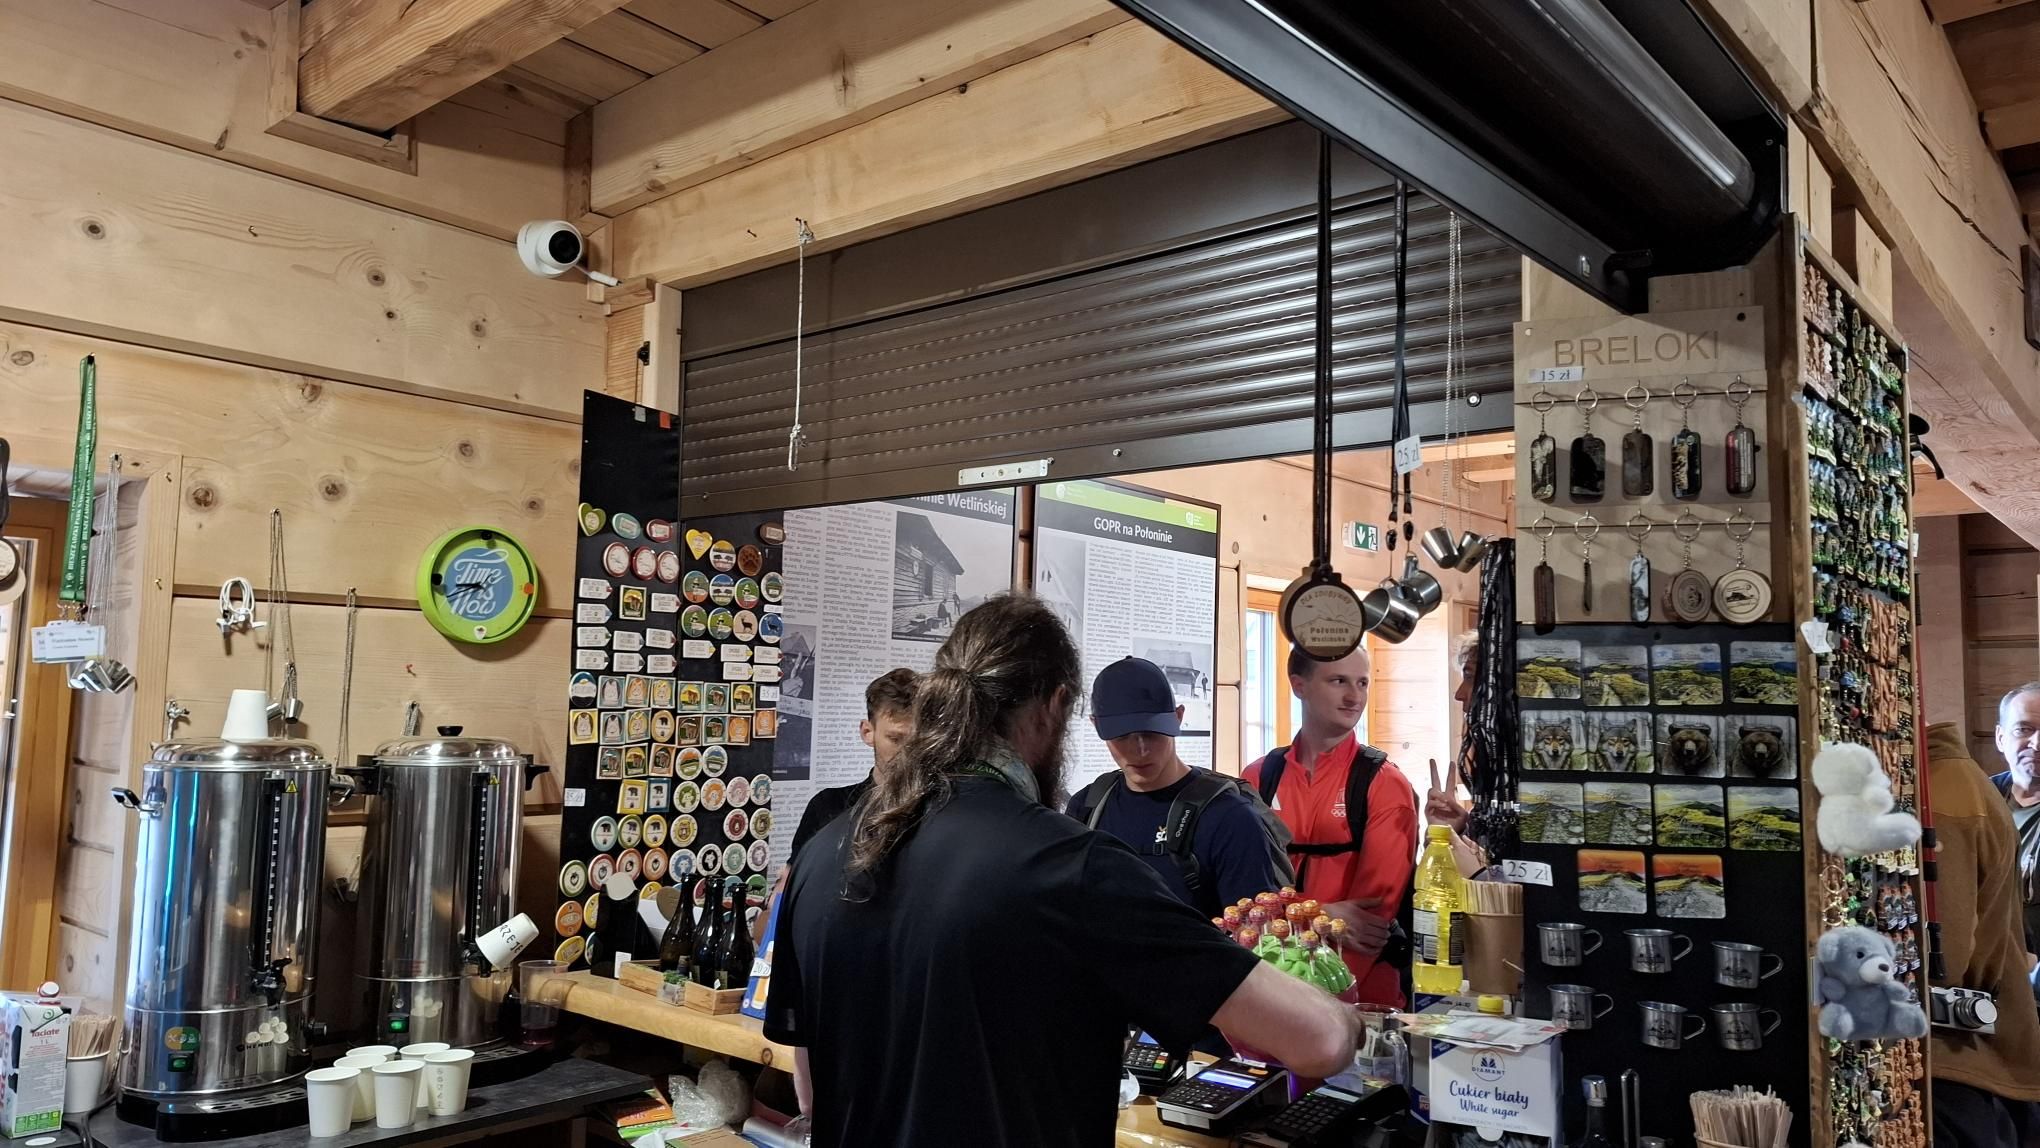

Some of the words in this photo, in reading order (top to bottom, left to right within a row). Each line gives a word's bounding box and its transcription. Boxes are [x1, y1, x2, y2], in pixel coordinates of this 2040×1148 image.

[1554, 331, 1719, 368] BRELOKI
[1541, 371, 1555, 381] 15
[1397, 447, 1410, 467] 25
[947, 493, 1007, 519] Wetlińskiej
[1094, 517, 1121, 534] GOPR
[1122, 526, 1133, 537] na
[1134, 524, 1173, 543] Połoninie
[1507, 861, 1528, 878] 25
[1471, 1066, 1506, 1075] DIAMANT
[1449, 1079, 1491, 1100] Cukier
[1494, 1086, 1529, 1109] biały
[1460, 1098, 1488, 1114] White
[1491, 1105, 1520, 1120] sugar
